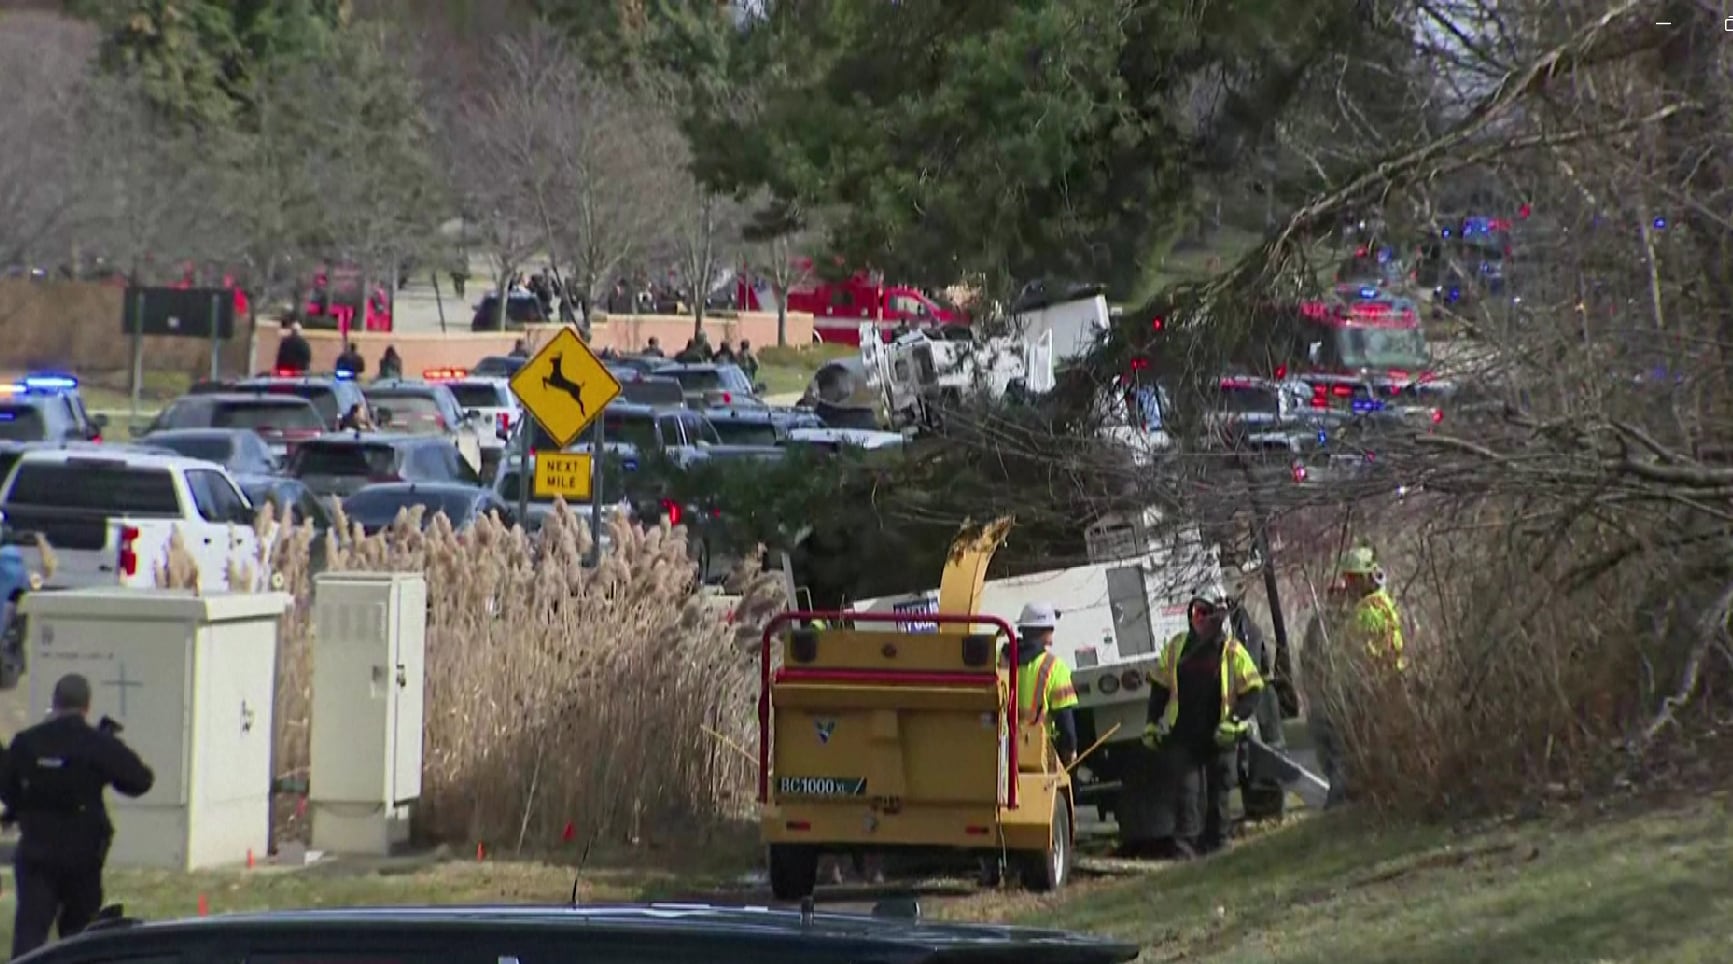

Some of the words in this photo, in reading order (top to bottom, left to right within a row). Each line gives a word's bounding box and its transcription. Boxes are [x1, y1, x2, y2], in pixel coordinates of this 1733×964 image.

[547, 461, 578, 472] NEXT
[547, 476, 576, 489] MILE
[781, 776, 835, 793] BC1000
